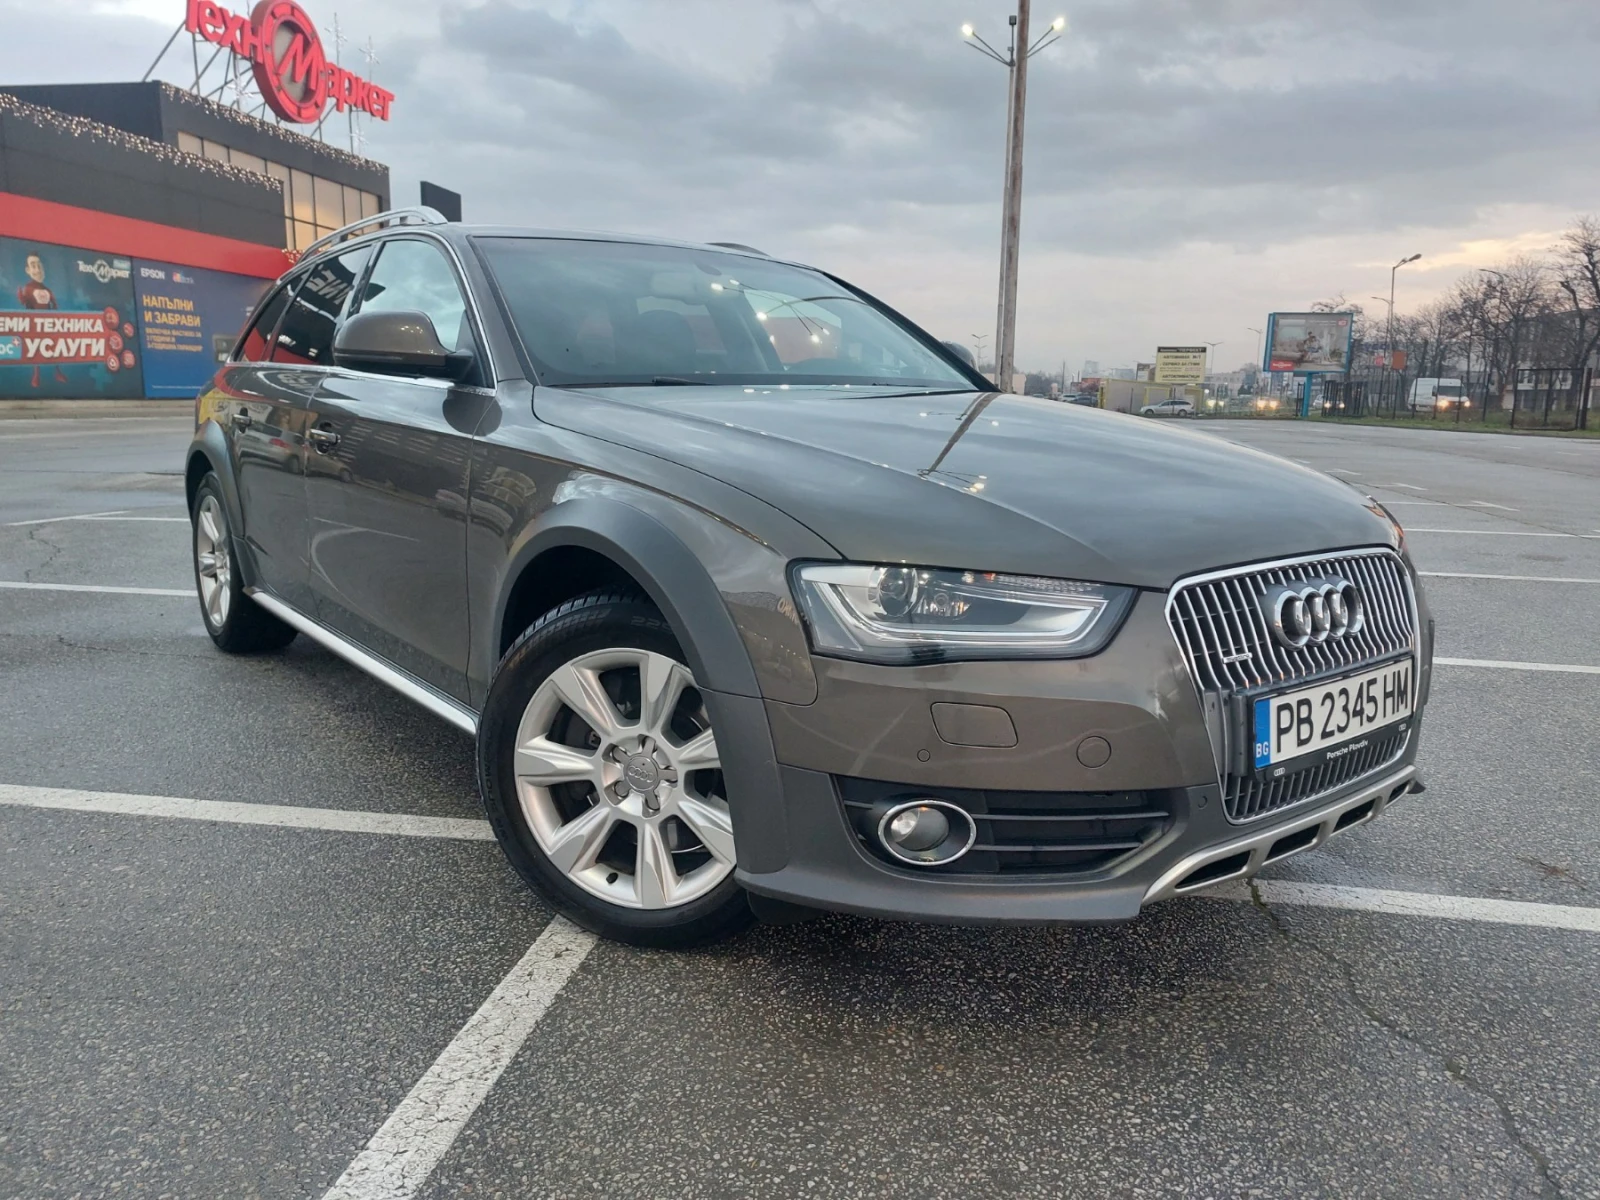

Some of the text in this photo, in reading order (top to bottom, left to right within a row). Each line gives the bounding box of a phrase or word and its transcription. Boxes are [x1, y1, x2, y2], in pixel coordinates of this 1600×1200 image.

[140, 267, 165, 280] EPSON
[143, 295, 194, 311] НАПЪЛНИ
[34, 317, 104, 333] ТЕХНИКА
[144, 311, 201, 327] И ЗАБРАВИ
[25, 338, 105, 358] УСЛУГИ
[1276, 666, 1409, 753] PB 2345 HM
[1255, 741, 1269, 758] BG
[1326, 739, 1369, 760] Porsche Plovdiv
